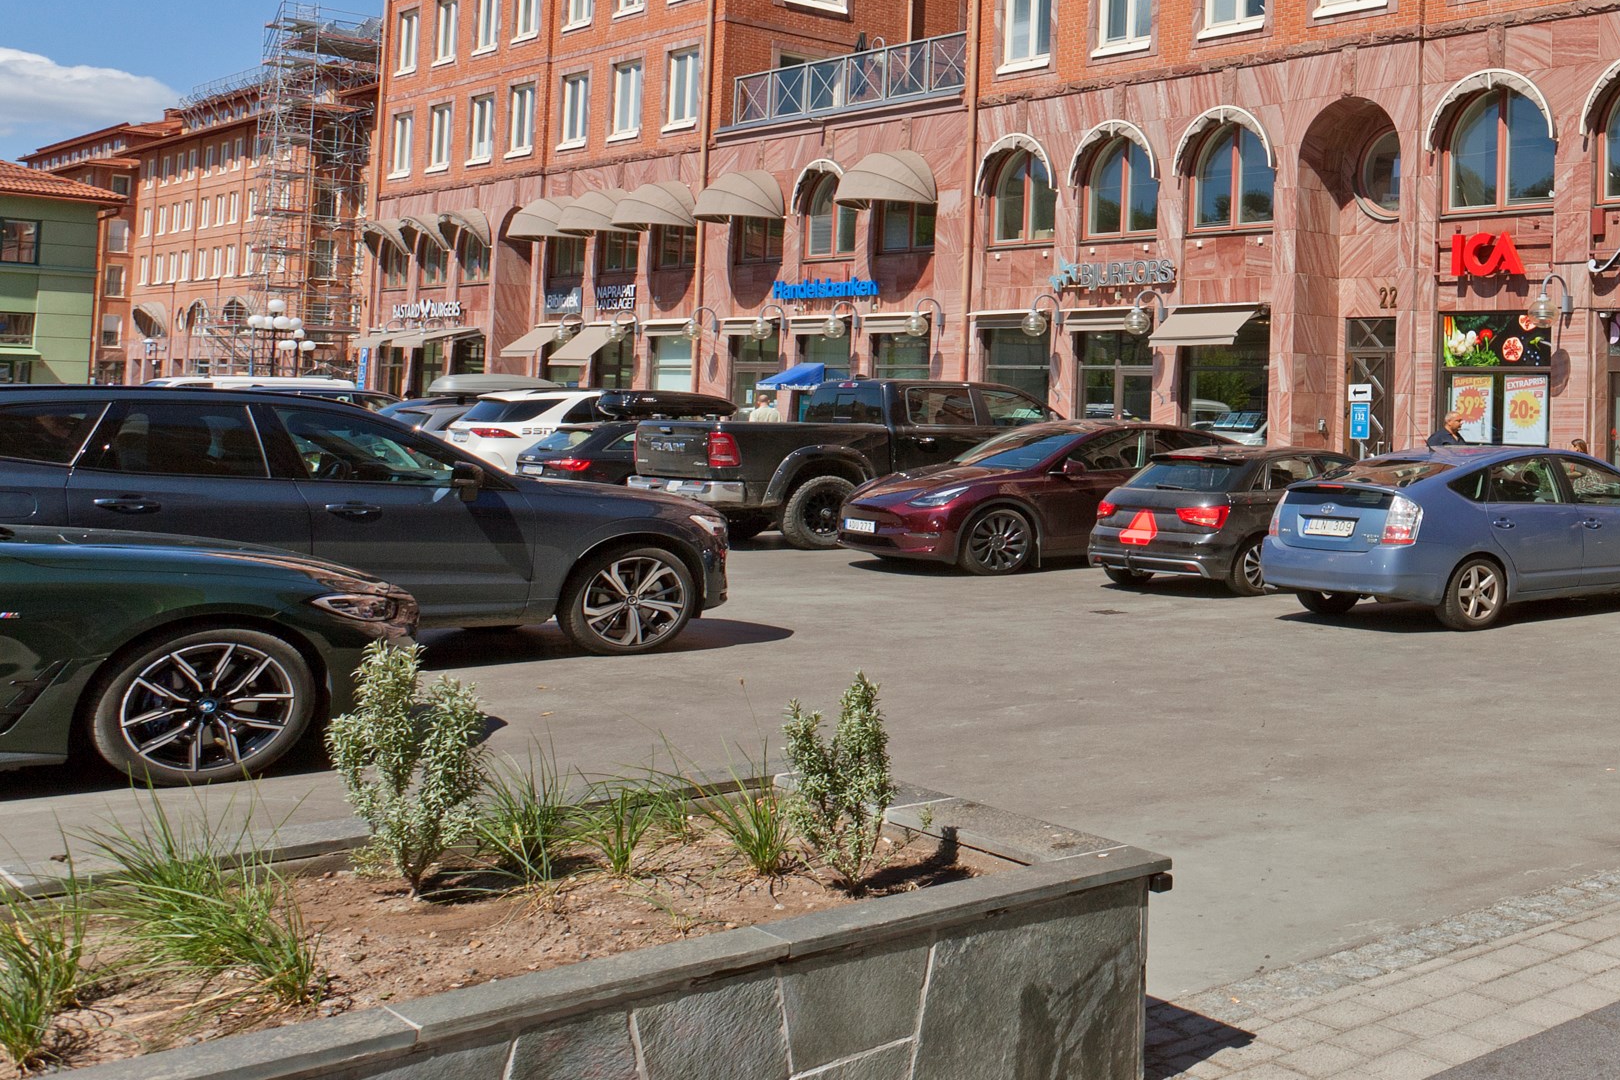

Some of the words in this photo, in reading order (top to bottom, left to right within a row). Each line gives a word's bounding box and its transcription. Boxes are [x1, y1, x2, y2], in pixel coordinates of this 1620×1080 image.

[1451, 231, 1526, 276] ICA
[1080, 259, 1173, 291] BJURFORS
[597, 284, 636, 299] NAPRAPAT
[773, 276, 879, 299] Handelsbanken
[547, 293, 579, 308] Bibliotek
[596, 298, 636, 310] LANDSLAGET
[1379, 286, 1398, 309] 22
[392, 304, 420, 318] BASTARD
[431, 301, 461, 317] BURGERS
[1506, 377, 1546, 390] EXTRAPRIS!
[1509, 400, 1540, 419] 20:-
[1309, 520, 1327, 530] LLN
[1333, 520, 1353, 532] 309
